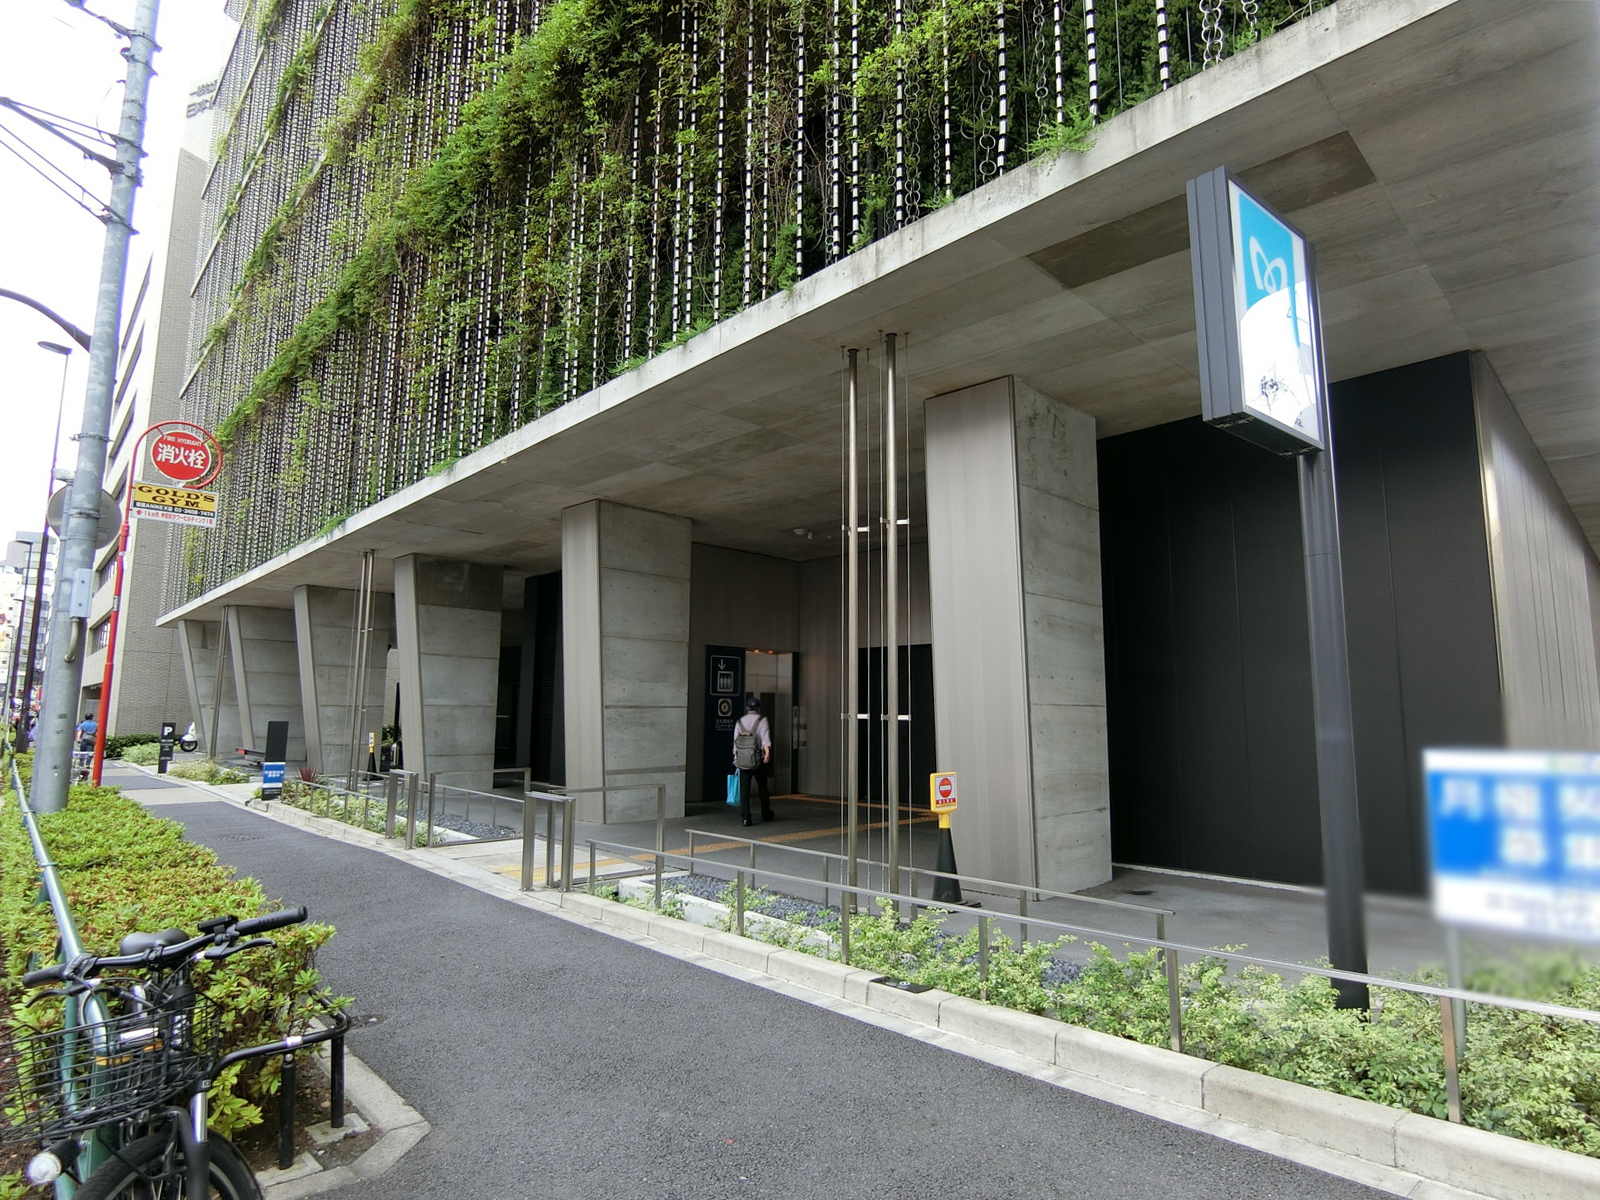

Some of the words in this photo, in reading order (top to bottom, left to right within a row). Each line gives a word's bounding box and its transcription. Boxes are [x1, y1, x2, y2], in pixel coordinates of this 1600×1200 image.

[177, 438, 202, 447] HYDRANT
[157, 443, 206, 468] 消火栓
[138, 486, 215, 503] GOLD'S
[152, 496, 201, 508] GYM
[164, 727, 173, 736] P
